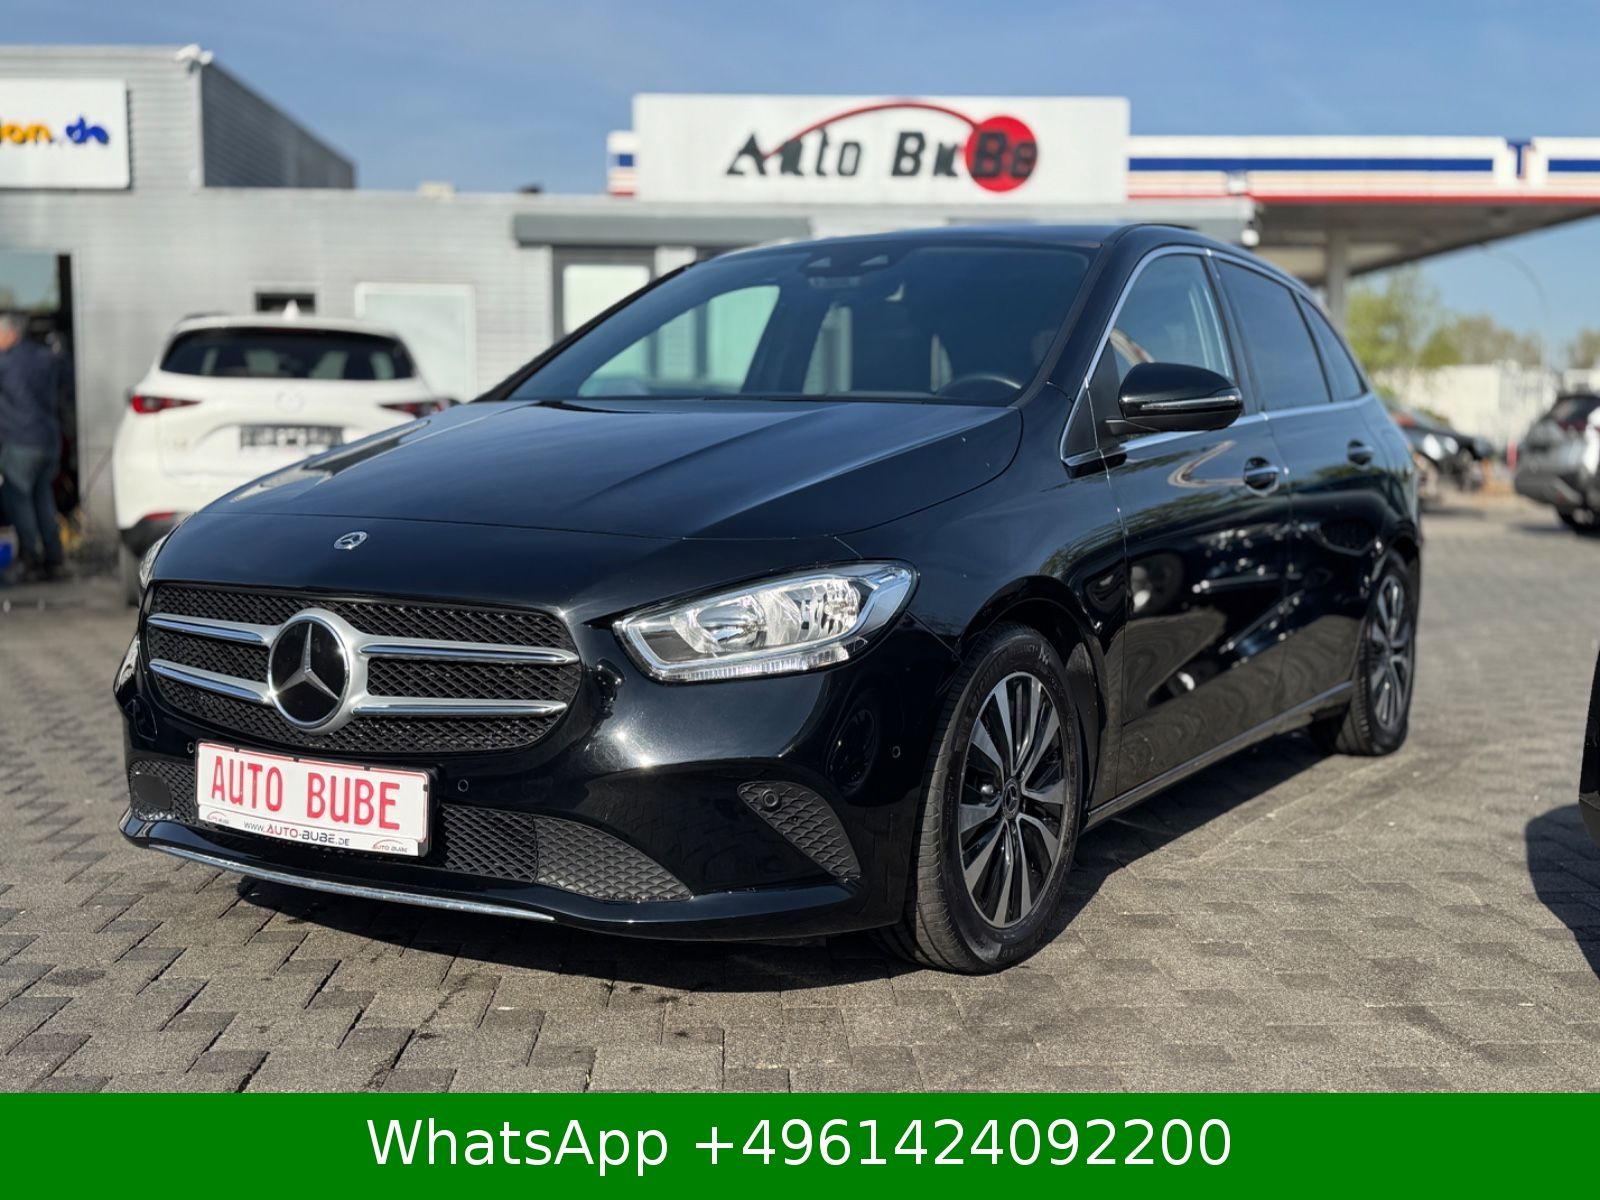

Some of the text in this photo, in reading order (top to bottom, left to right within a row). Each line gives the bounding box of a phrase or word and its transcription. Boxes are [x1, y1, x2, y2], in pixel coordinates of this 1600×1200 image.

[726, 127, 862, 176] Auto
[211, 755, 400, 830] AUTO BUBE
